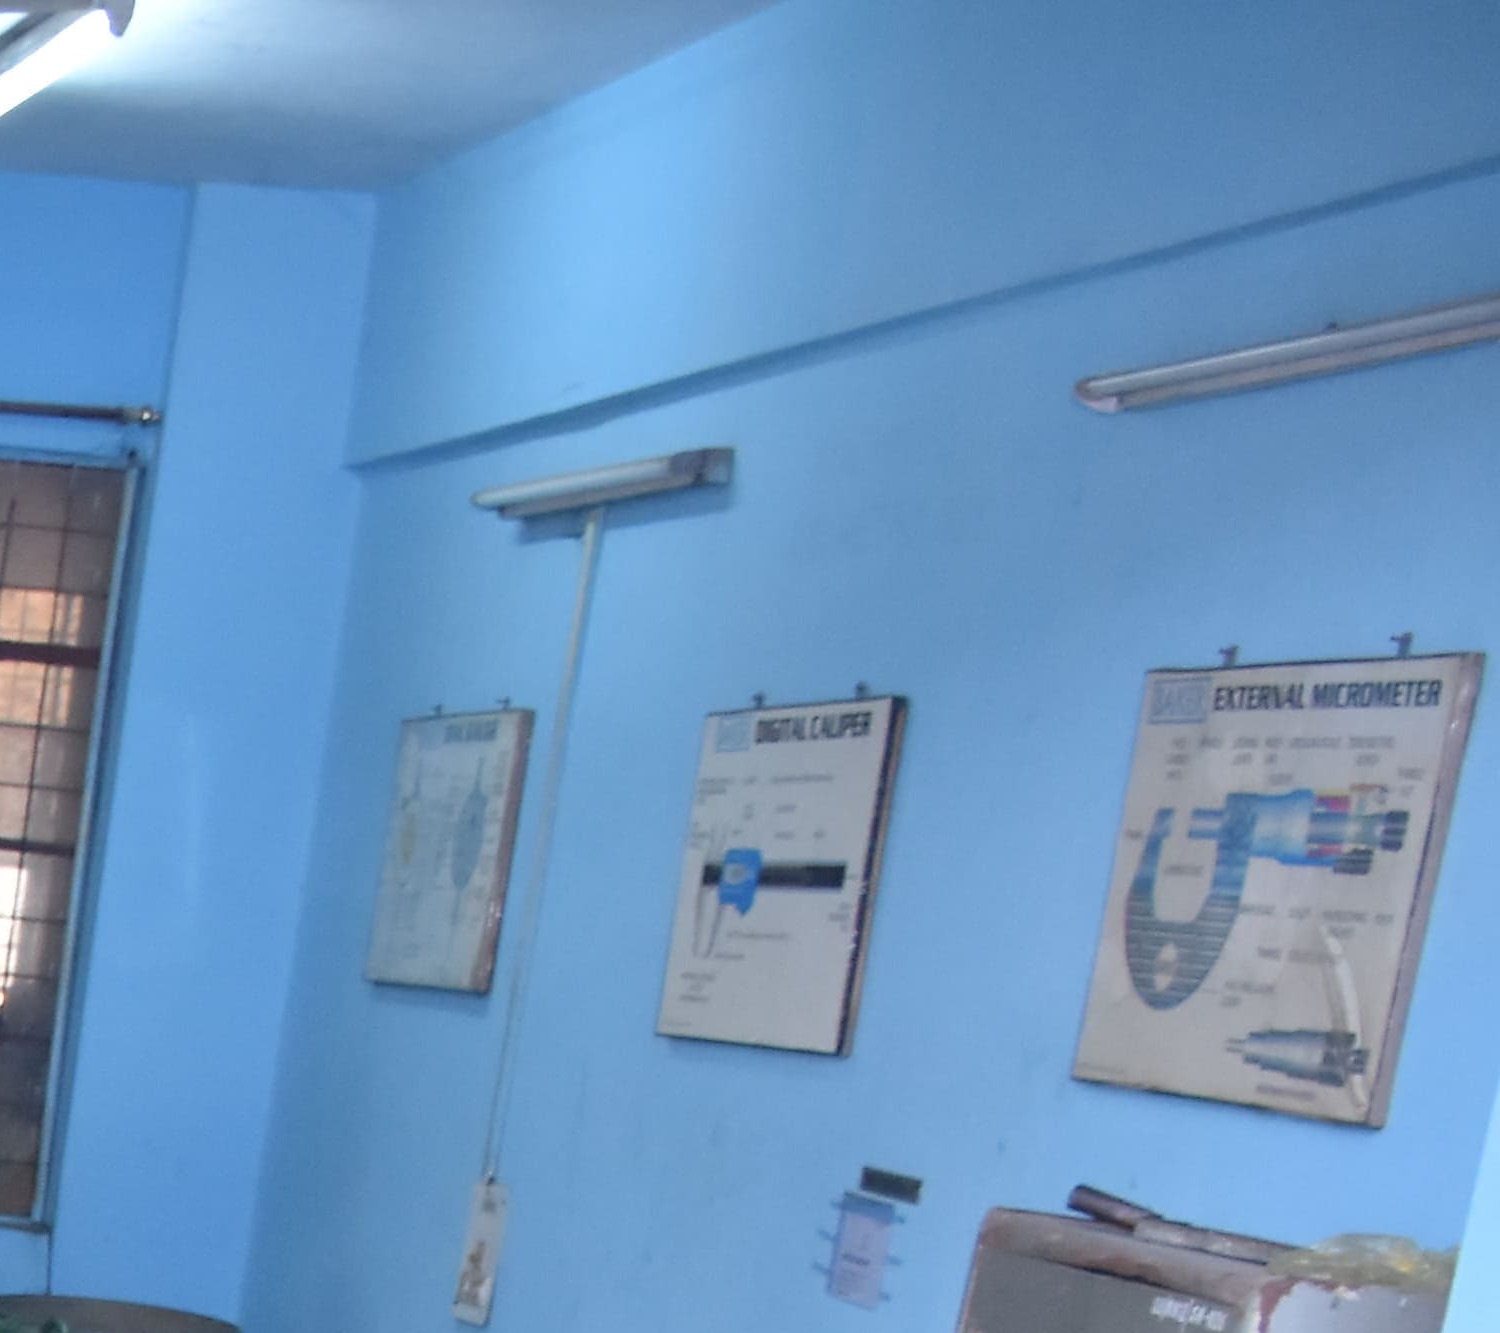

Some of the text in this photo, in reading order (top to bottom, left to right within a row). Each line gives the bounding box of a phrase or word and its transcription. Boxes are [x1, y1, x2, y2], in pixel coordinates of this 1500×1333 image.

[1213, 679, 1444, 711] EXTERNAL MICROMETER
[754, 710, 873, 745] DIGITAL CALIPER
